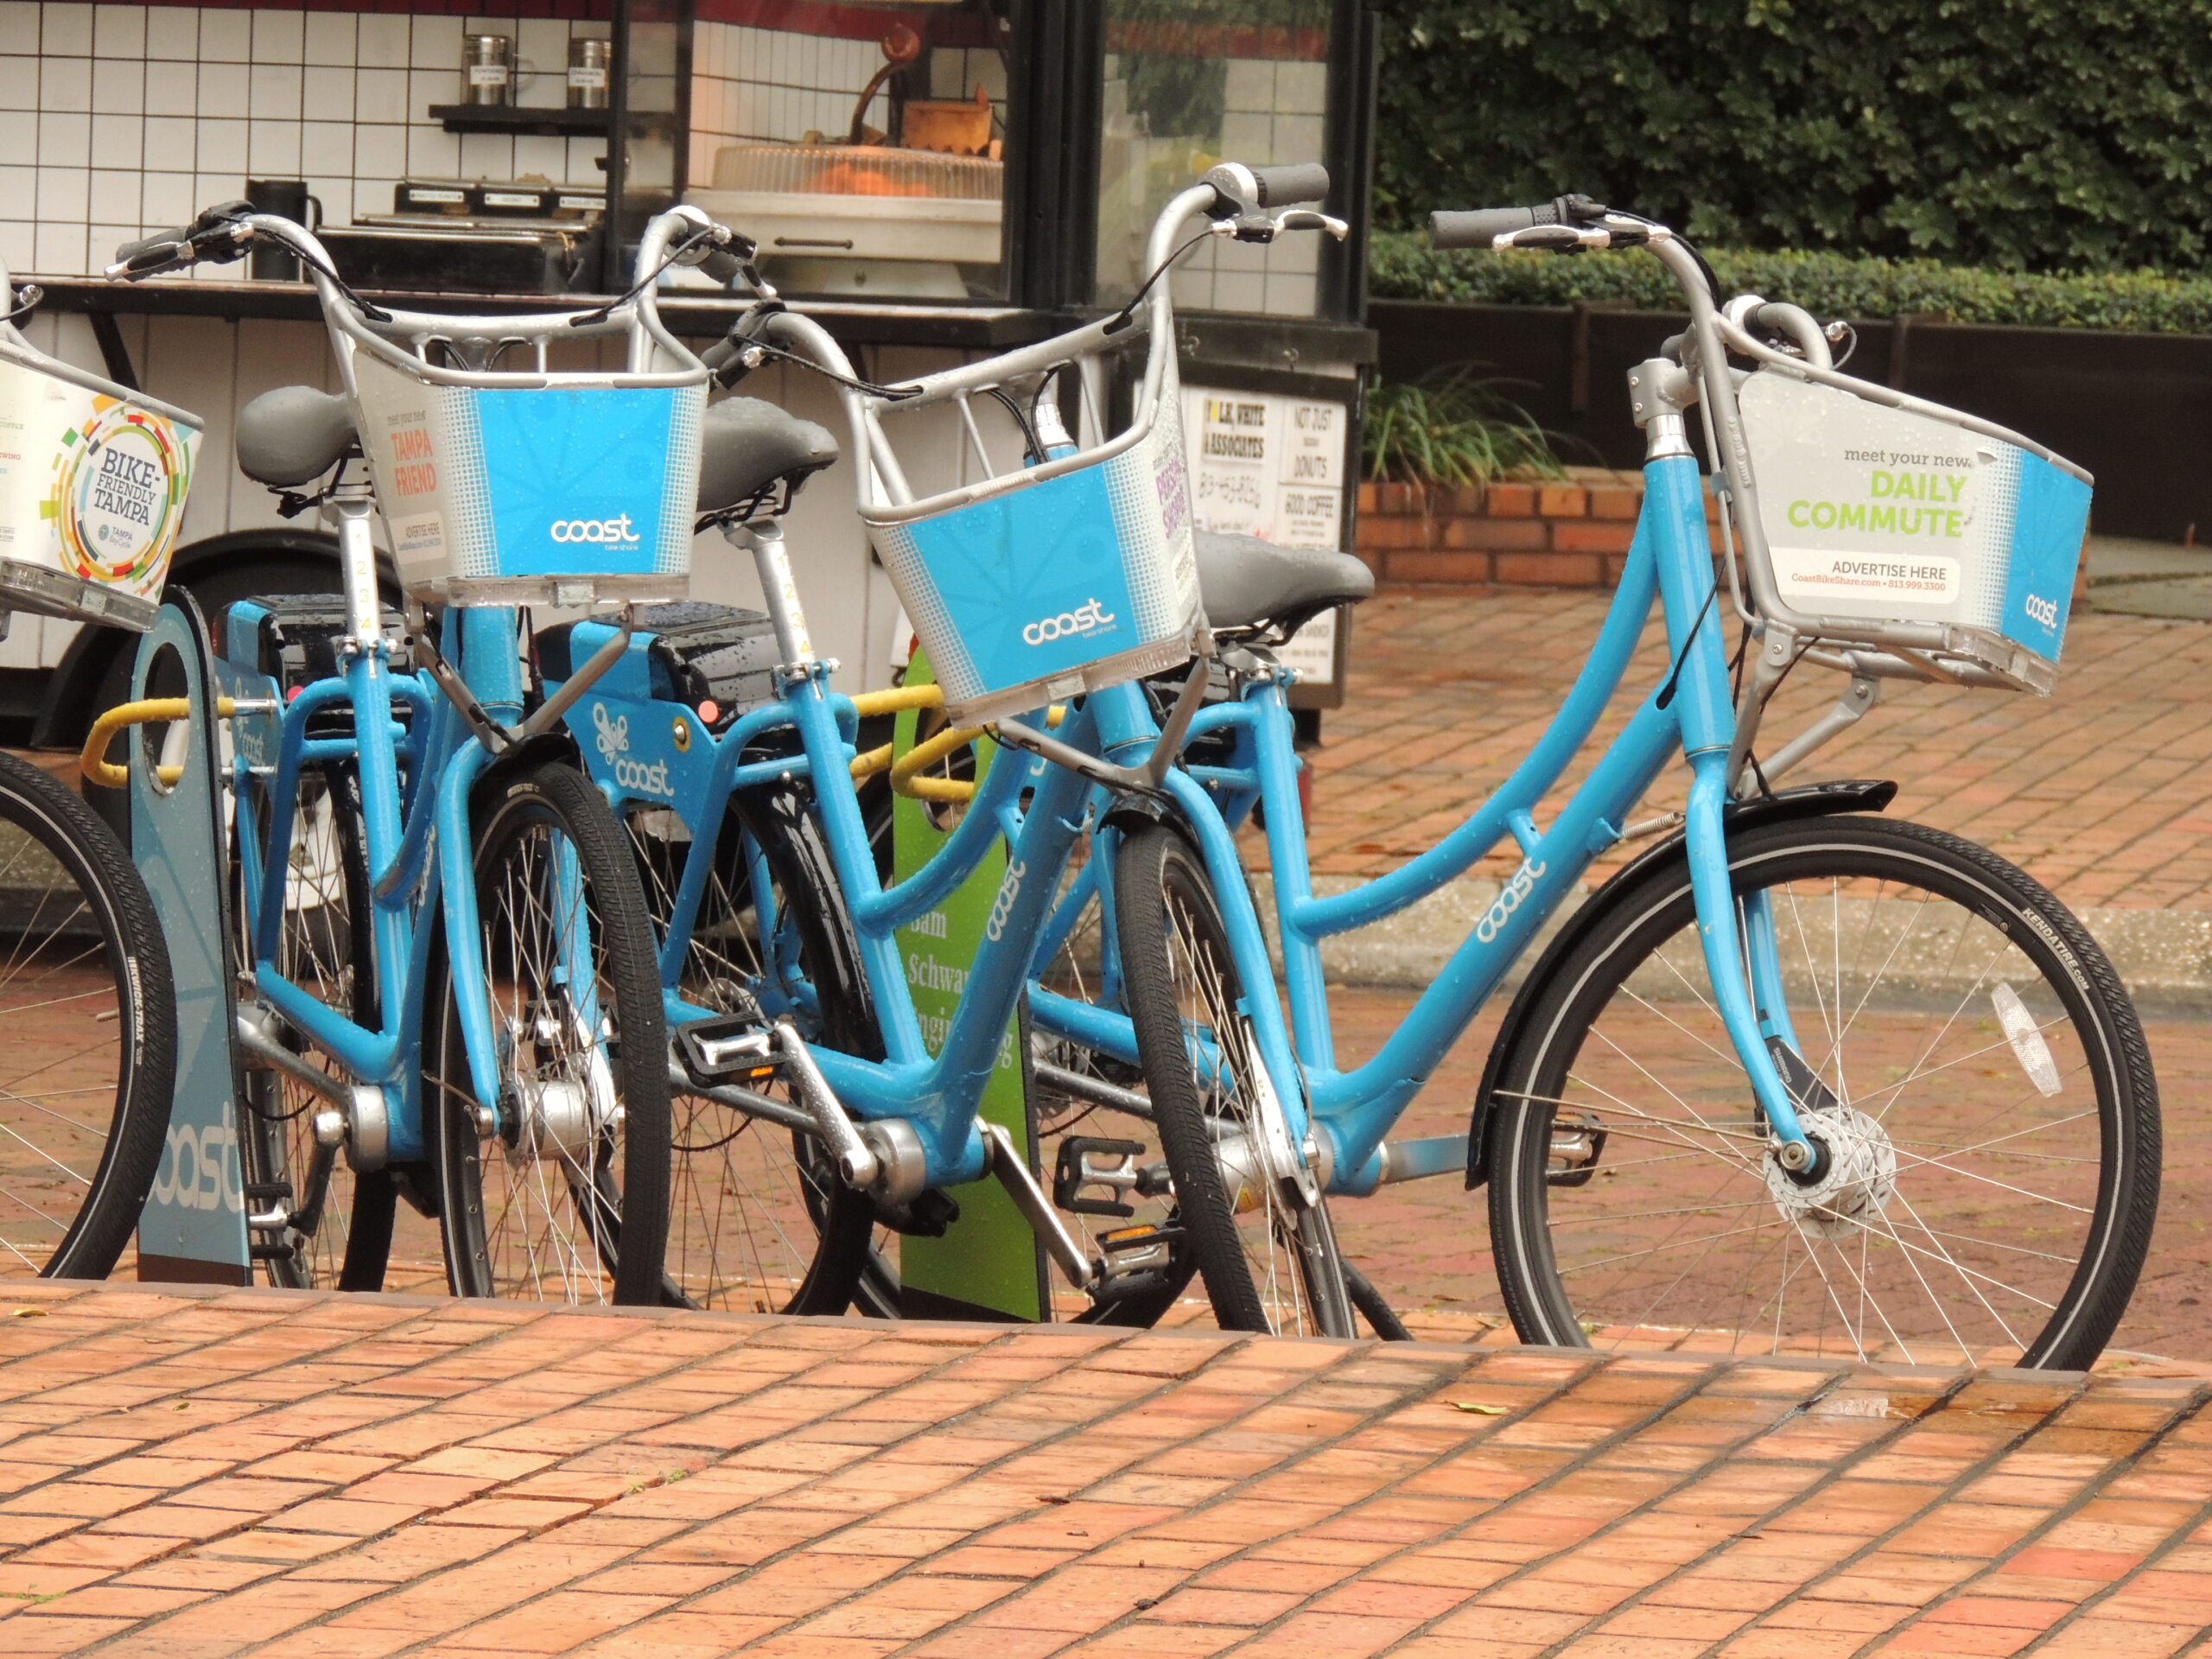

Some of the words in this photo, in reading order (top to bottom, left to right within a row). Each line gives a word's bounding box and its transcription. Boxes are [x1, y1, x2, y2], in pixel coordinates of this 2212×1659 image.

[391, 429, 434, 461] TAMPA
[1211, 432, 1265, 460] ASSOCIATES
[1844, 448, 1886, 463] meet
[1889, 452, 1930, 467] your
[100, 447, 161, 489] BIKE-
[394, 462, 437, 497] FRIEND
[1294, 454, 1328, 479] DONUTS
[97, 473, 157, 505] FRIENDLY
[1871, 469, 1969, 504] DAILY
[94, 487, 150, 527] TAMPA
[1787, 499, 1964, 539] COMMUTE
[111, 526, 133, 541] TAMPA
[550, 512, 641, 543] coast
[1790, 572, 1882, 588] CoastBikeShare.com
[1887, 579, 1947, 592] 813.999.3300
[1831, 560, 1908, 578] ADVERTISE
[1910, 566, 1948, 582] HERE
[1022, 597, 1116, 646] coast
[2025, 593, 2058, 630] coast
[615, 758, 675, 798] coast
[2022, 907, 2090, 991] KENDATIRE.COM
[145, 1100, 246, 1214] oast
